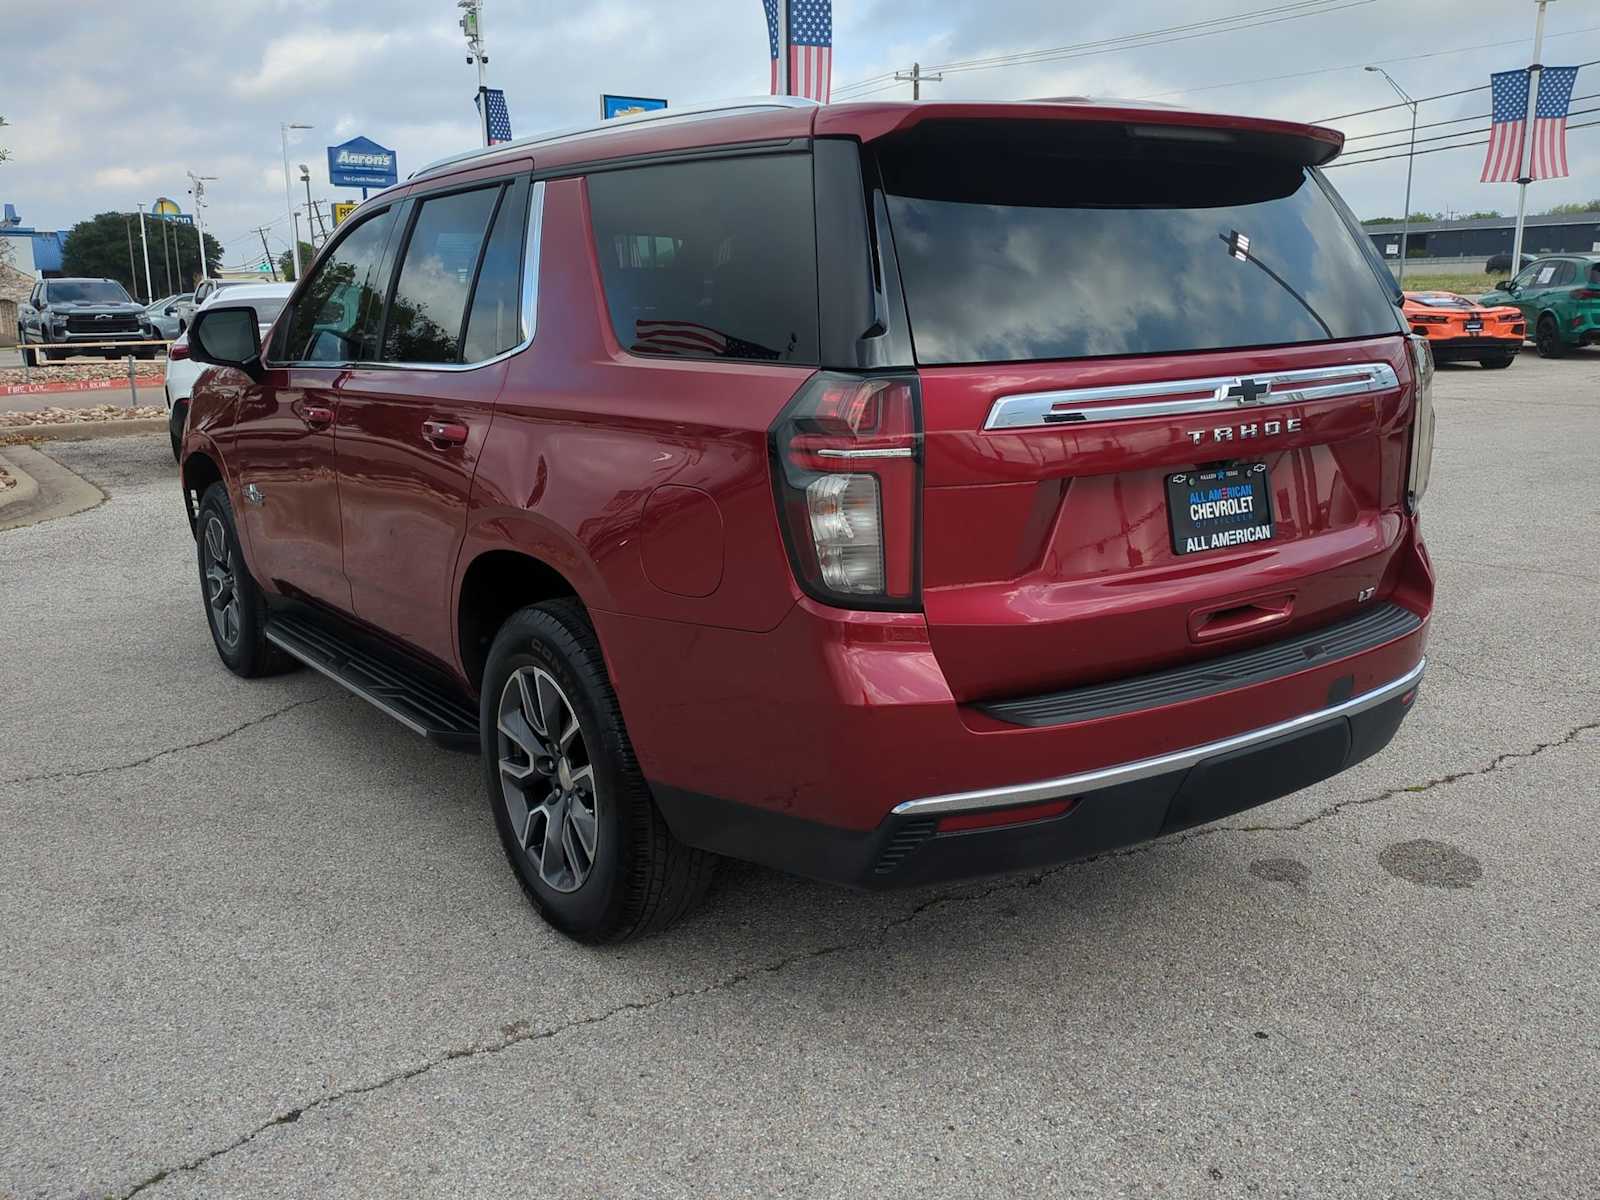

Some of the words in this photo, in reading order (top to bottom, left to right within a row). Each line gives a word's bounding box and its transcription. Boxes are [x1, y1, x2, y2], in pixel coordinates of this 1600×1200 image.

[337, 150, 391, 166] Aaron's
[1187, 418, 1301, 445] TAHOE
[1190, 491, 1207, 504] ALL
[1209, 484, 1252, 500] AMERICAN
[1190, 496, 1253, 521] CHEVROLET
[1187, 535, 1209, 552] ALL
[1211, 524, 1271, 548] AMERICAN
[1358, 587, 1375, 602] LT
